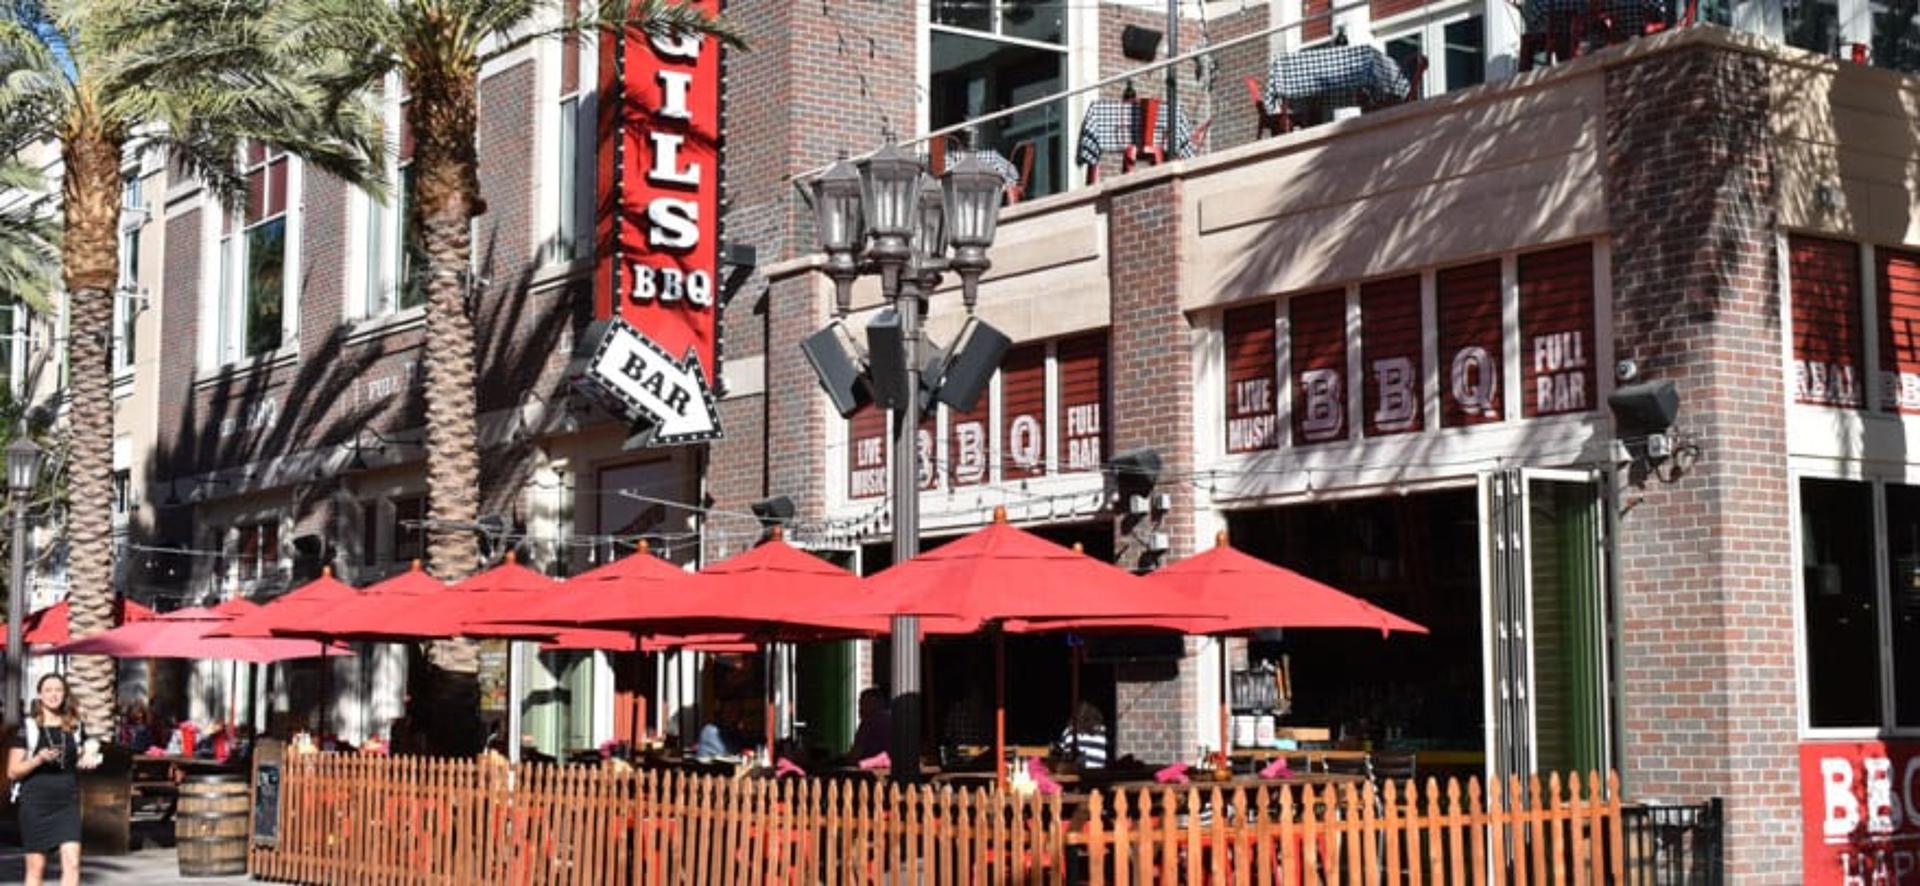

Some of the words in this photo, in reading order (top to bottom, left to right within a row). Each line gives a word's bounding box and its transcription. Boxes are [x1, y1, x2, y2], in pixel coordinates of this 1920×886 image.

[632, 264, 712, 306] BBQ
[1534, 330, 1586, 372] FULL
[619, 350, 690, 417] BAR
[1237, 378, 1271, 414] LIVE
[1536, 371, 1587, 413] BAR
[857, 436, 883, 467] LIVE
[1069, 436, 1101, 469] BAR
